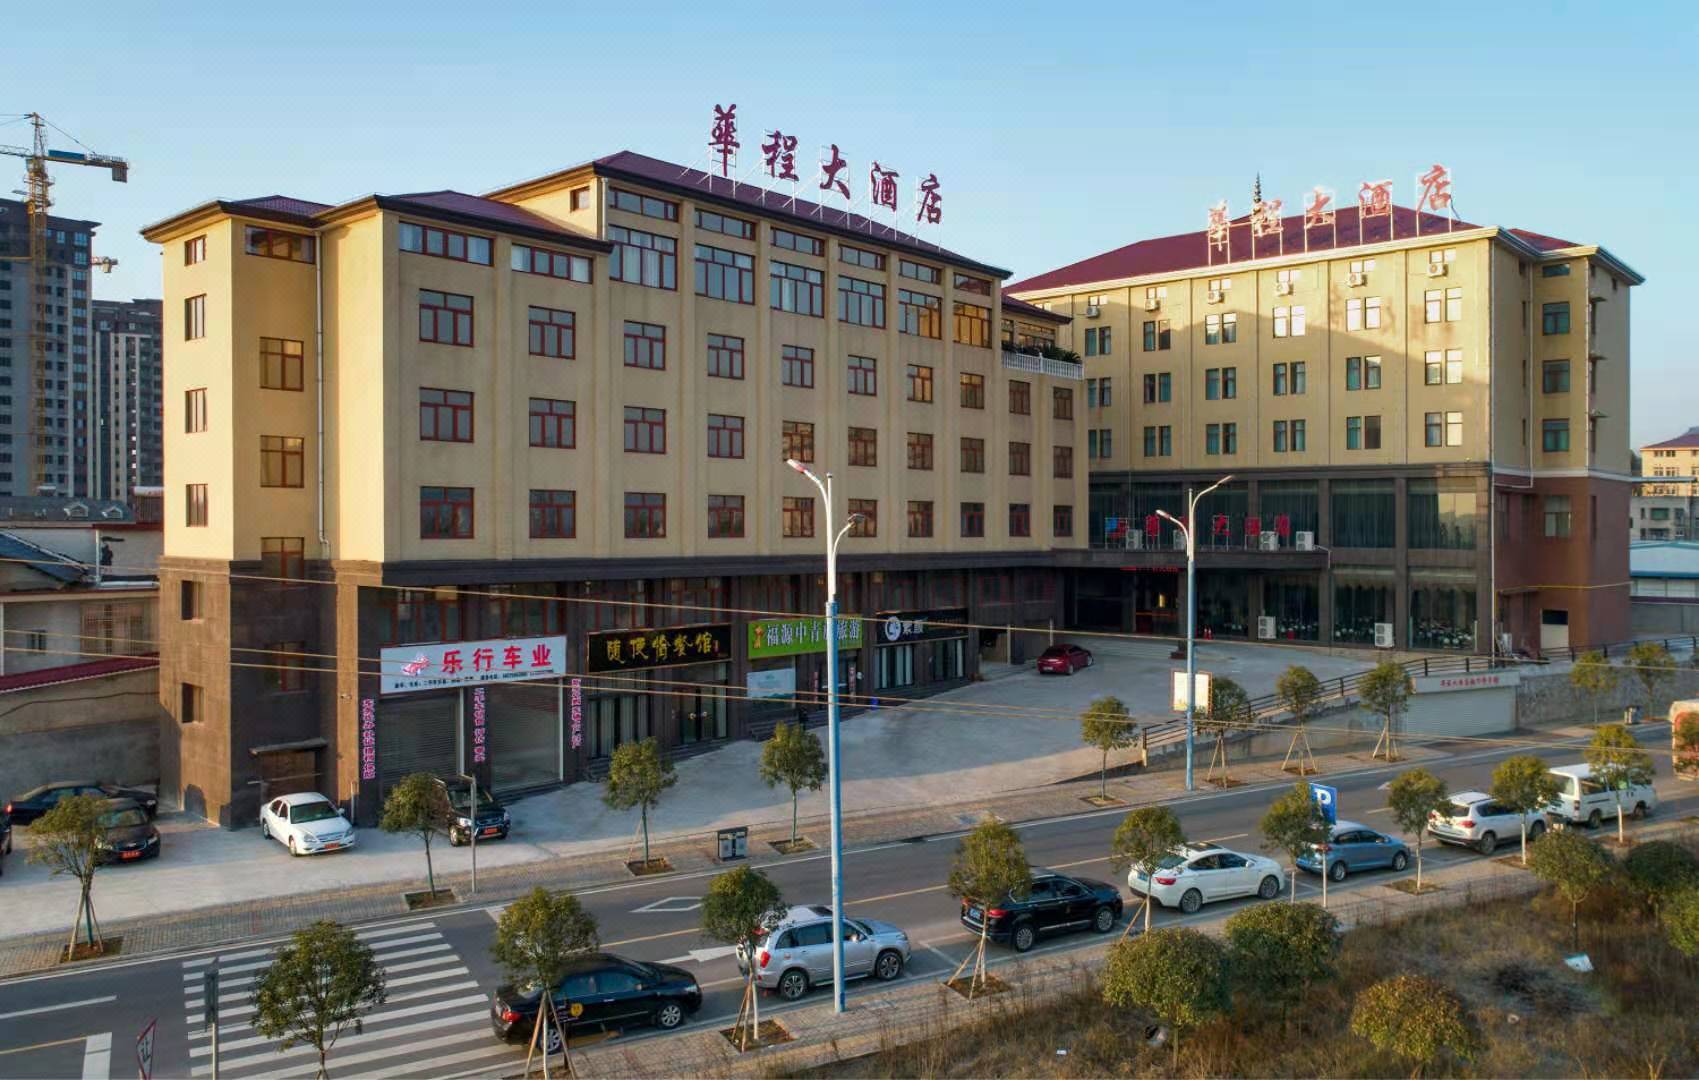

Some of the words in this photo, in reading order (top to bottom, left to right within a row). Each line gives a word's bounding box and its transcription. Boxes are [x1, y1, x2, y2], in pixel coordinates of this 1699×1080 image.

[442, 644, 553, 674] 乐行车业
[1314, 788, 1332, 817] P
